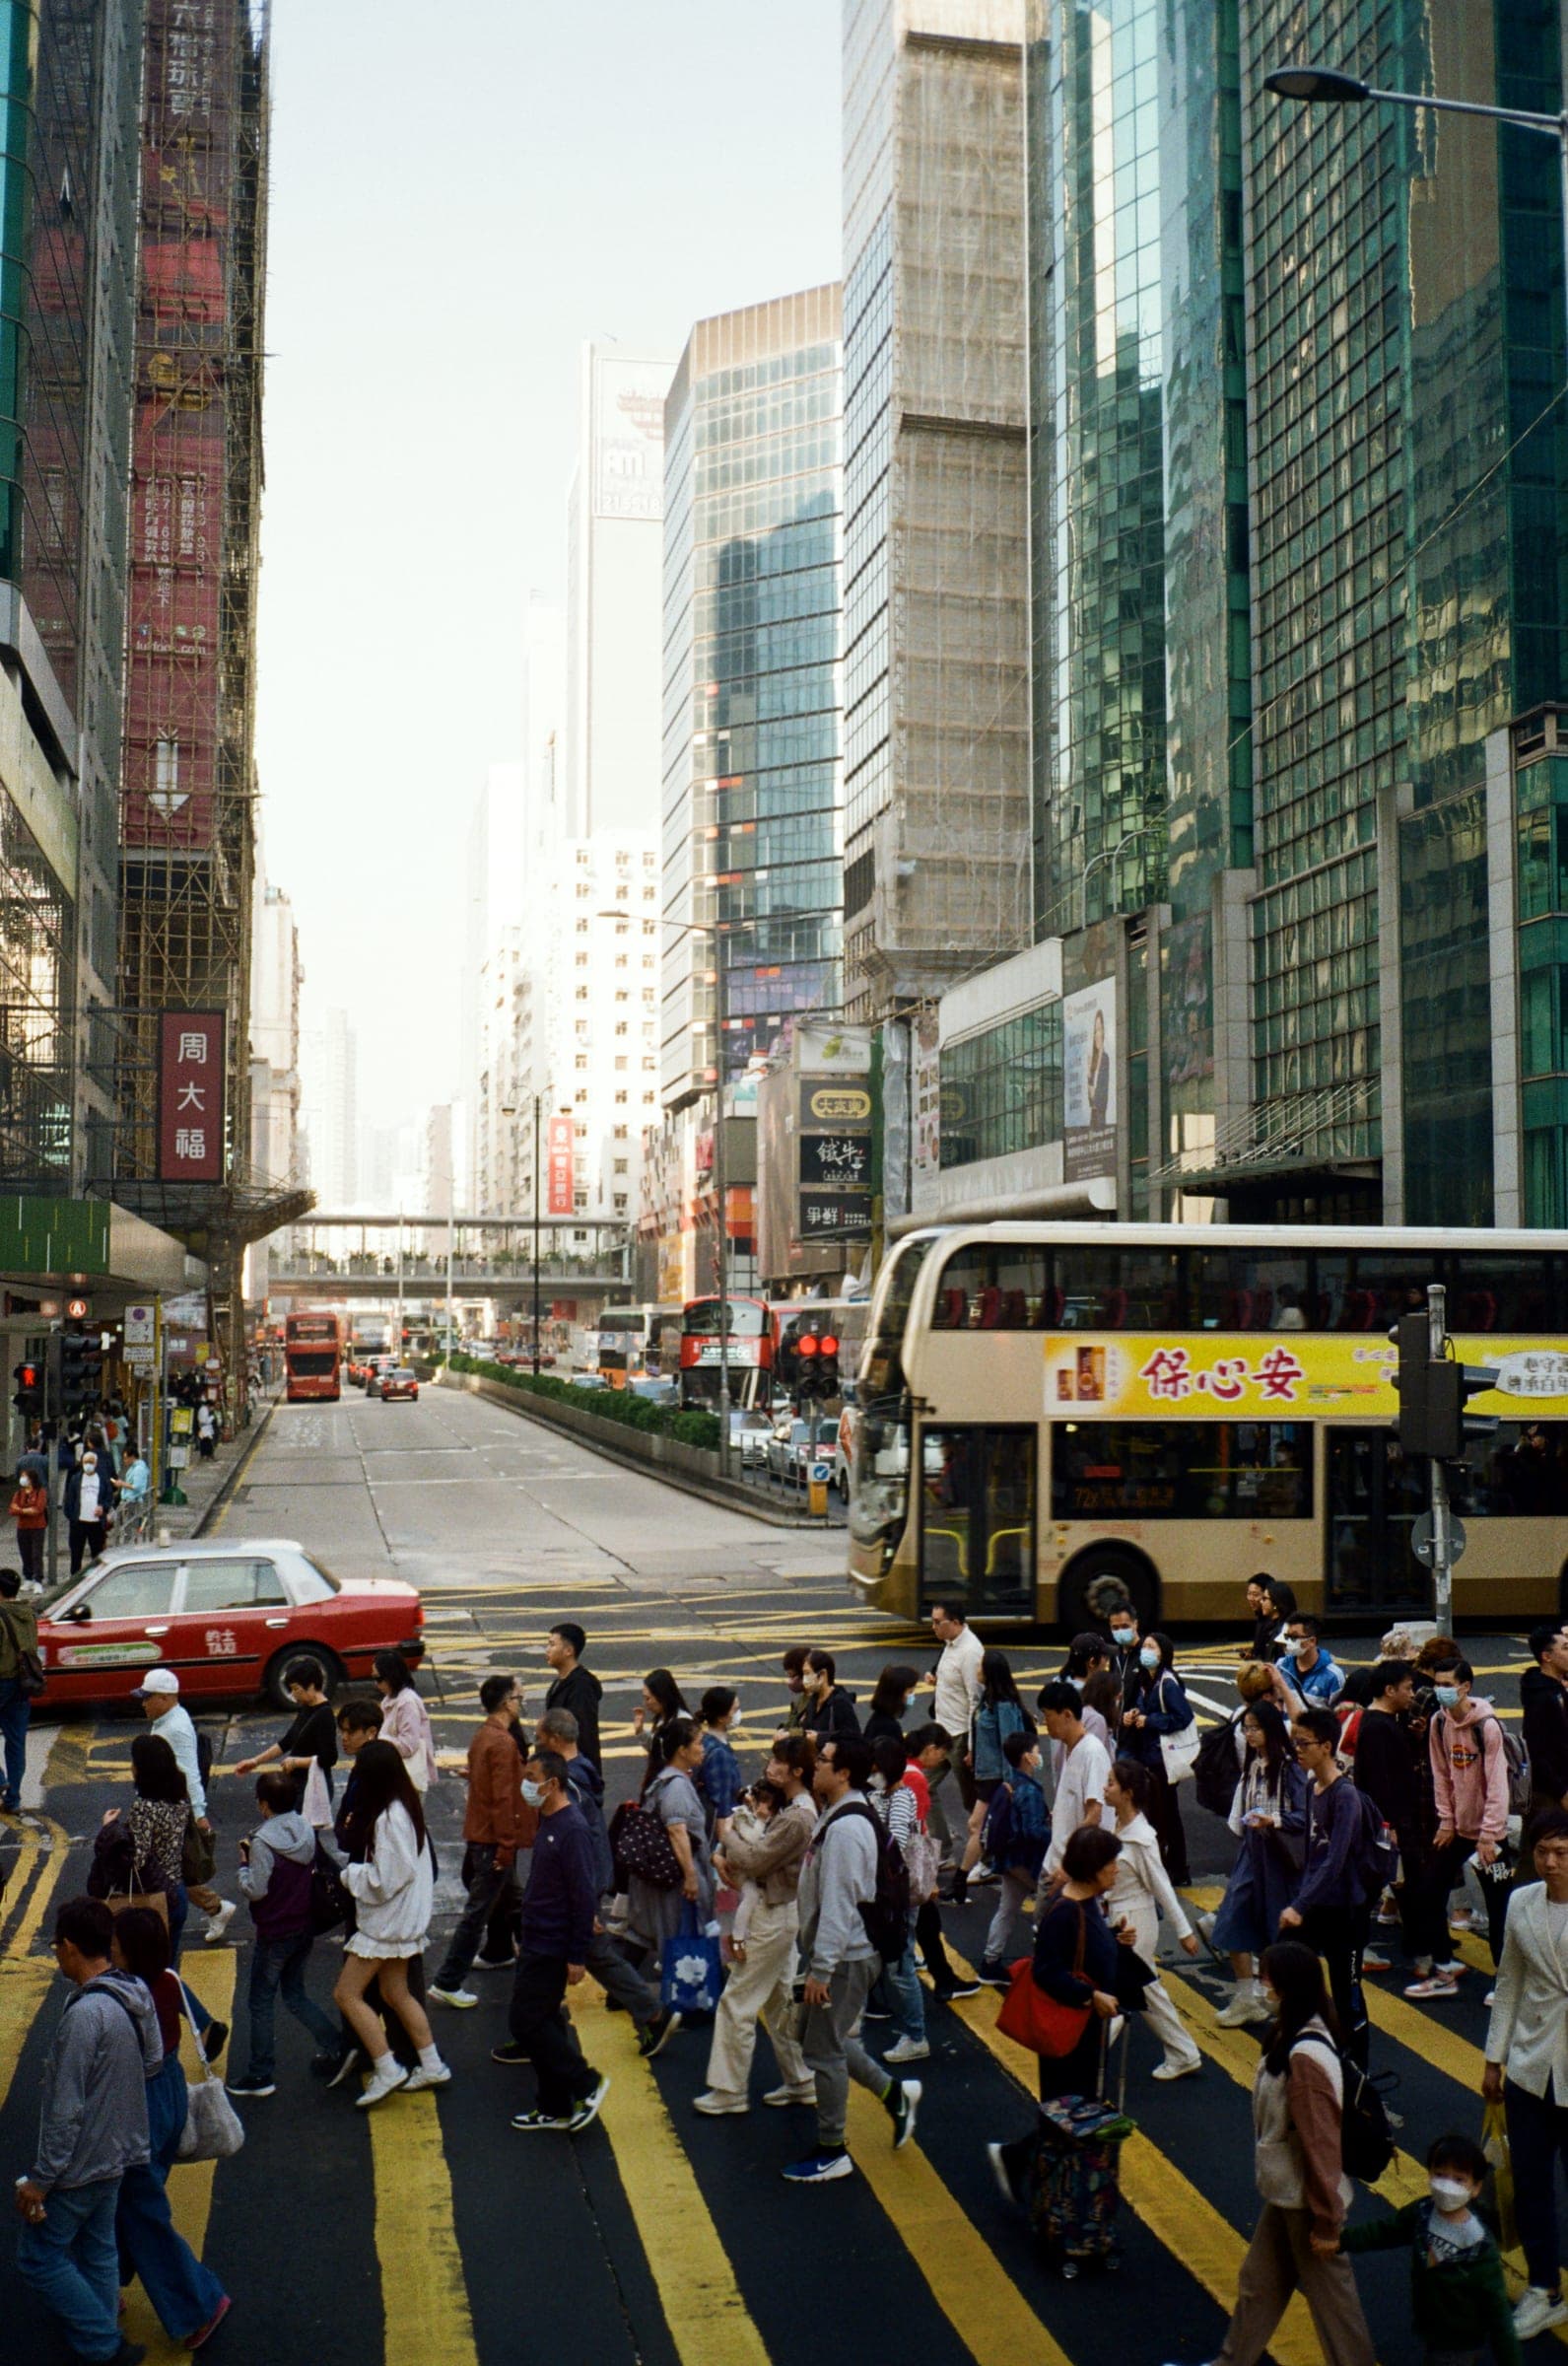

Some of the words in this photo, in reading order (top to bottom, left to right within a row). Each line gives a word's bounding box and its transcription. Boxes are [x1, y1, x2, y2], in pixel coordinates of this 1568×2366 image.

[175, 1032, 207, 1159] 周大福
[1140, 1348, 1303, 1400] 保心安
[206, 1641, 238, 1655] TAXI
